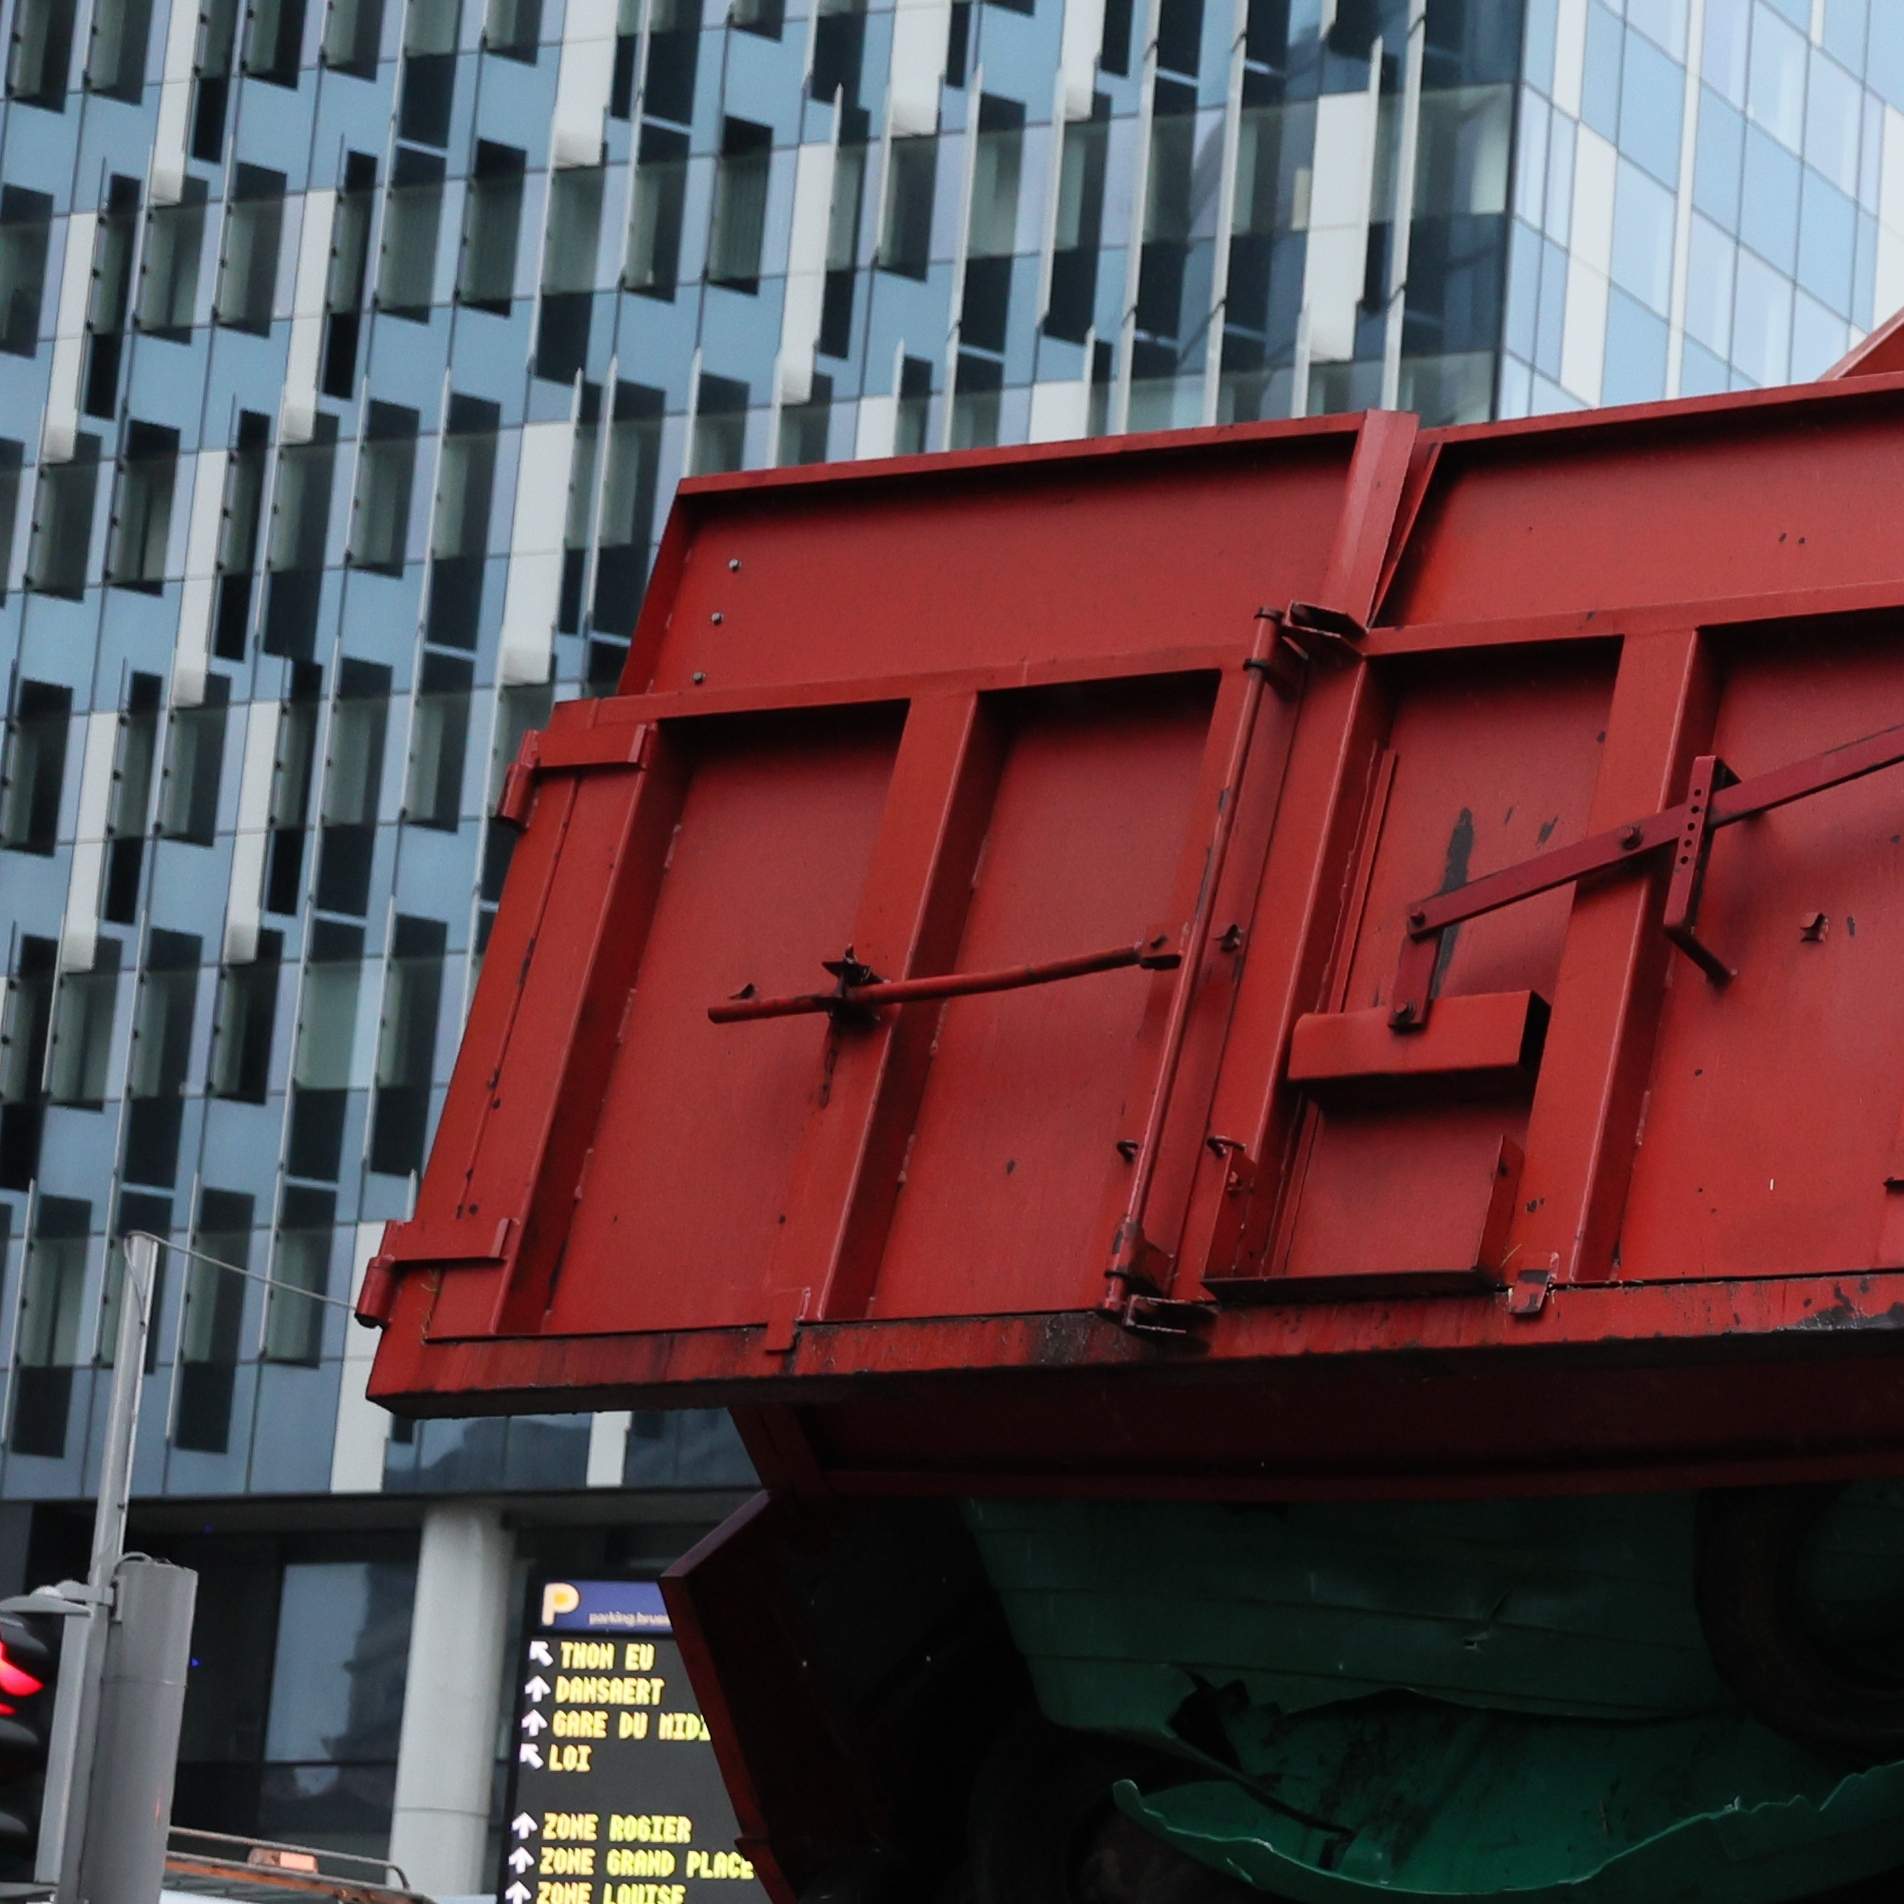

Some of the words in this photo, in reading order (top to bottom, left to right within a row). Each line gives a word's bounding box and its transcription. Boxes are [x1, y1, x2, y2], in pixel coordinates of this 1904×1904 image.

[560, 1641, 615, 1670] THON
[625, 1643, 655, 1671] EU
[555, 1675, 664, 1706] DANSAERT
[552, 1710, 609, 1739] GARE
[618, 1711, 649, 1740] DU
[548, 1744, 592, 1772] LOI
[542, 1812, 598, 1841] ZONE
[608, 1814, 692, 1843] ROGIER
[539, 1846, 595, 1876] ZONE
[606, 1849, 675, 1877] GRAND
